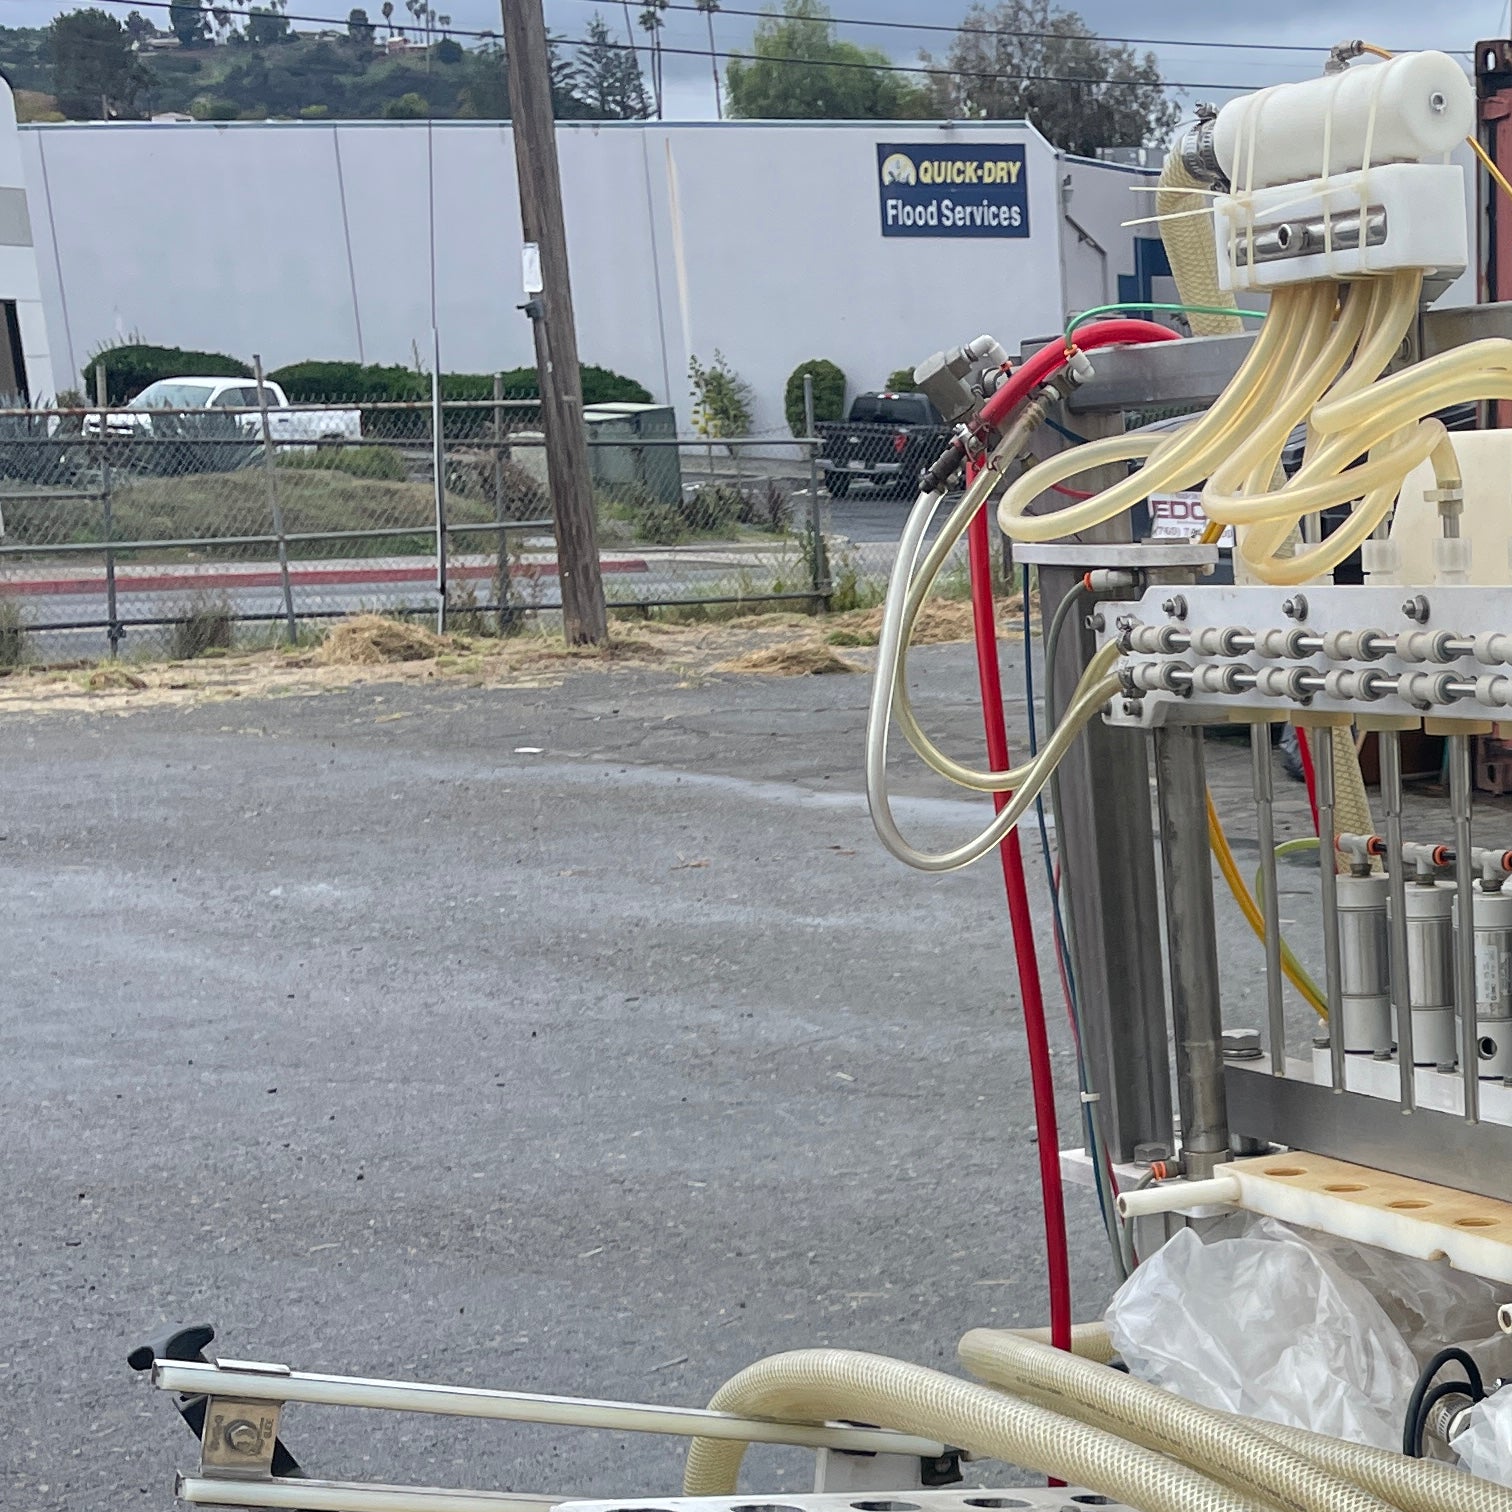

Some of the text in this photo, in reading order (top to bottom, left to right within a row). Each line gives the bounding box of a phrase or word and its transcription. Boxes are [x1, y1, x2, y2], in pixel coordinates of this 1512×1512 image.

[919, 160, 1022, 184] QUICK-DRY
[886, 199, 1022, 227] Flood Services
